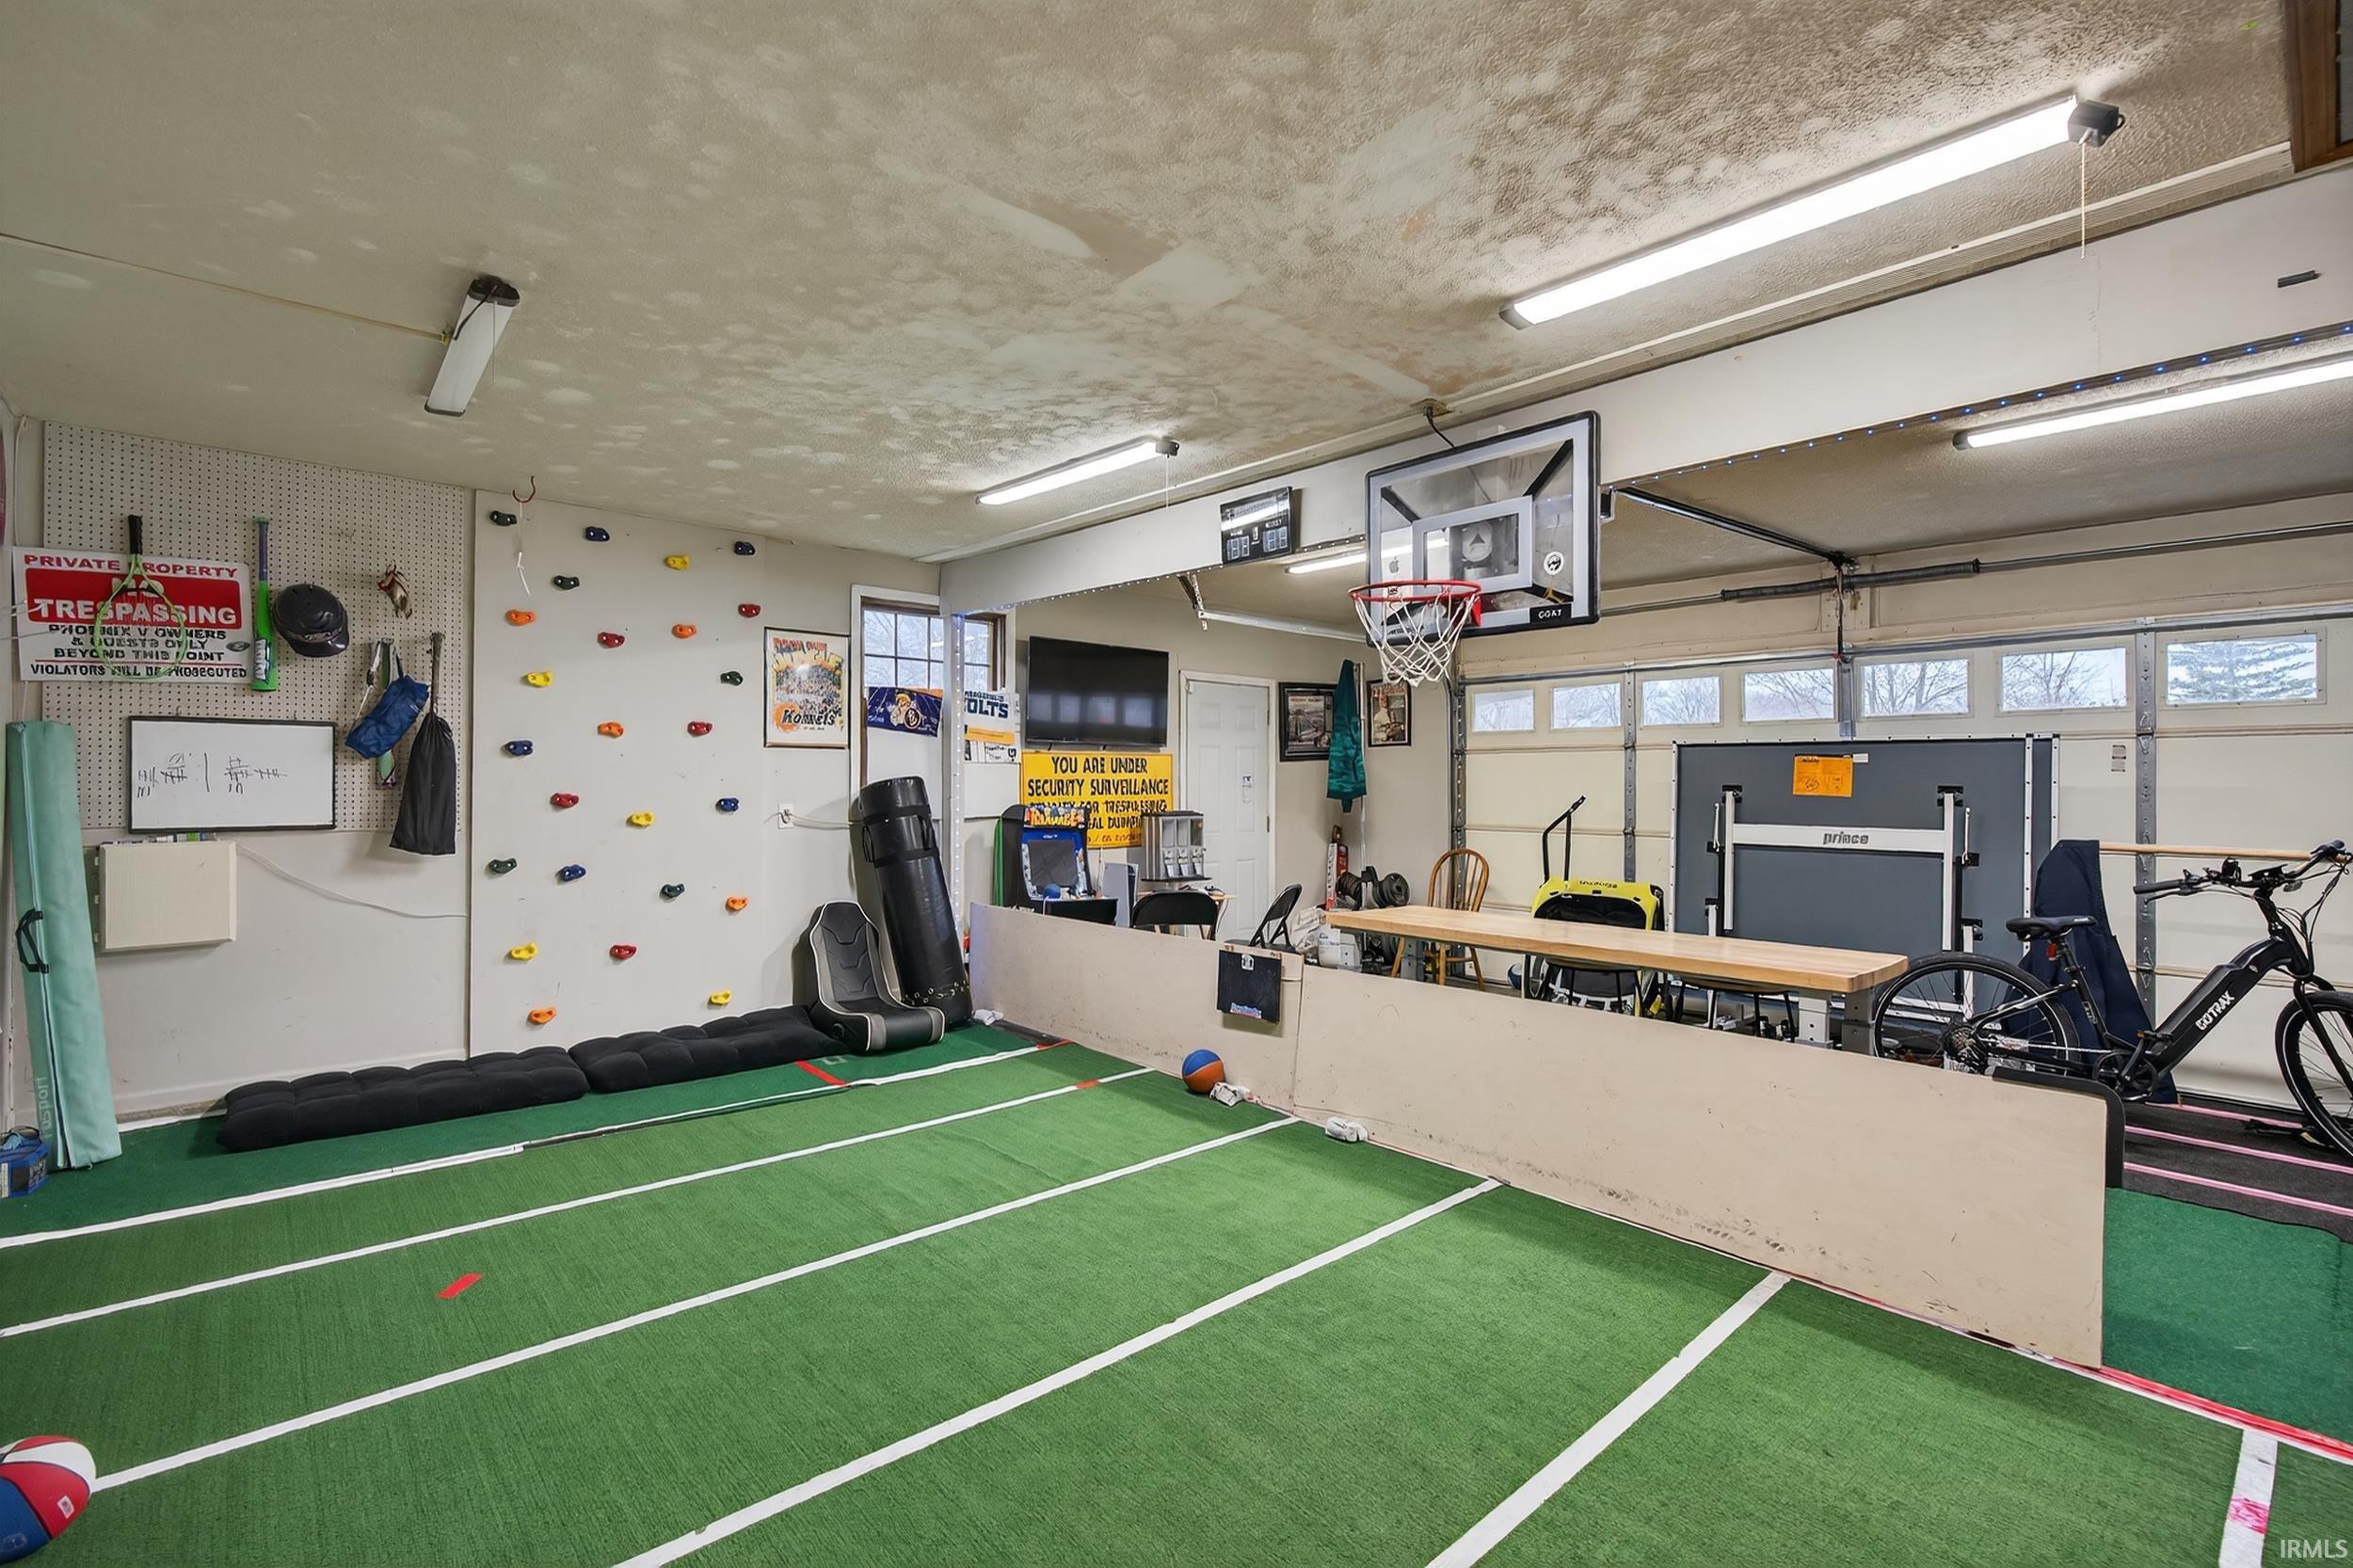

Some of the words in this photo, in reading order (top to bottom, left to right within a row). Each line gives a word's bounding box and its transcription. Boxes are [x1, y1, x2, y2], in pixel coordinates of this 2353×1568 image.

[24, 554, 120, 570] PRIVATE
[130, 562, 237, 578] ROPERTY
[34, 598, 236, 624] TRESPASSING
[31, 664, 105, 676] VIOLATORS
[965, 697, 1009, 719] OLTS
[1051, 757, 1078, 774] YOU
[1083, 757, 1105, 774] ARE
[1111, 757, 1147, 774] UNDER
[1028, 778, 1084, 796] SECURITY
[1823, 831, 1869, 845] prince
